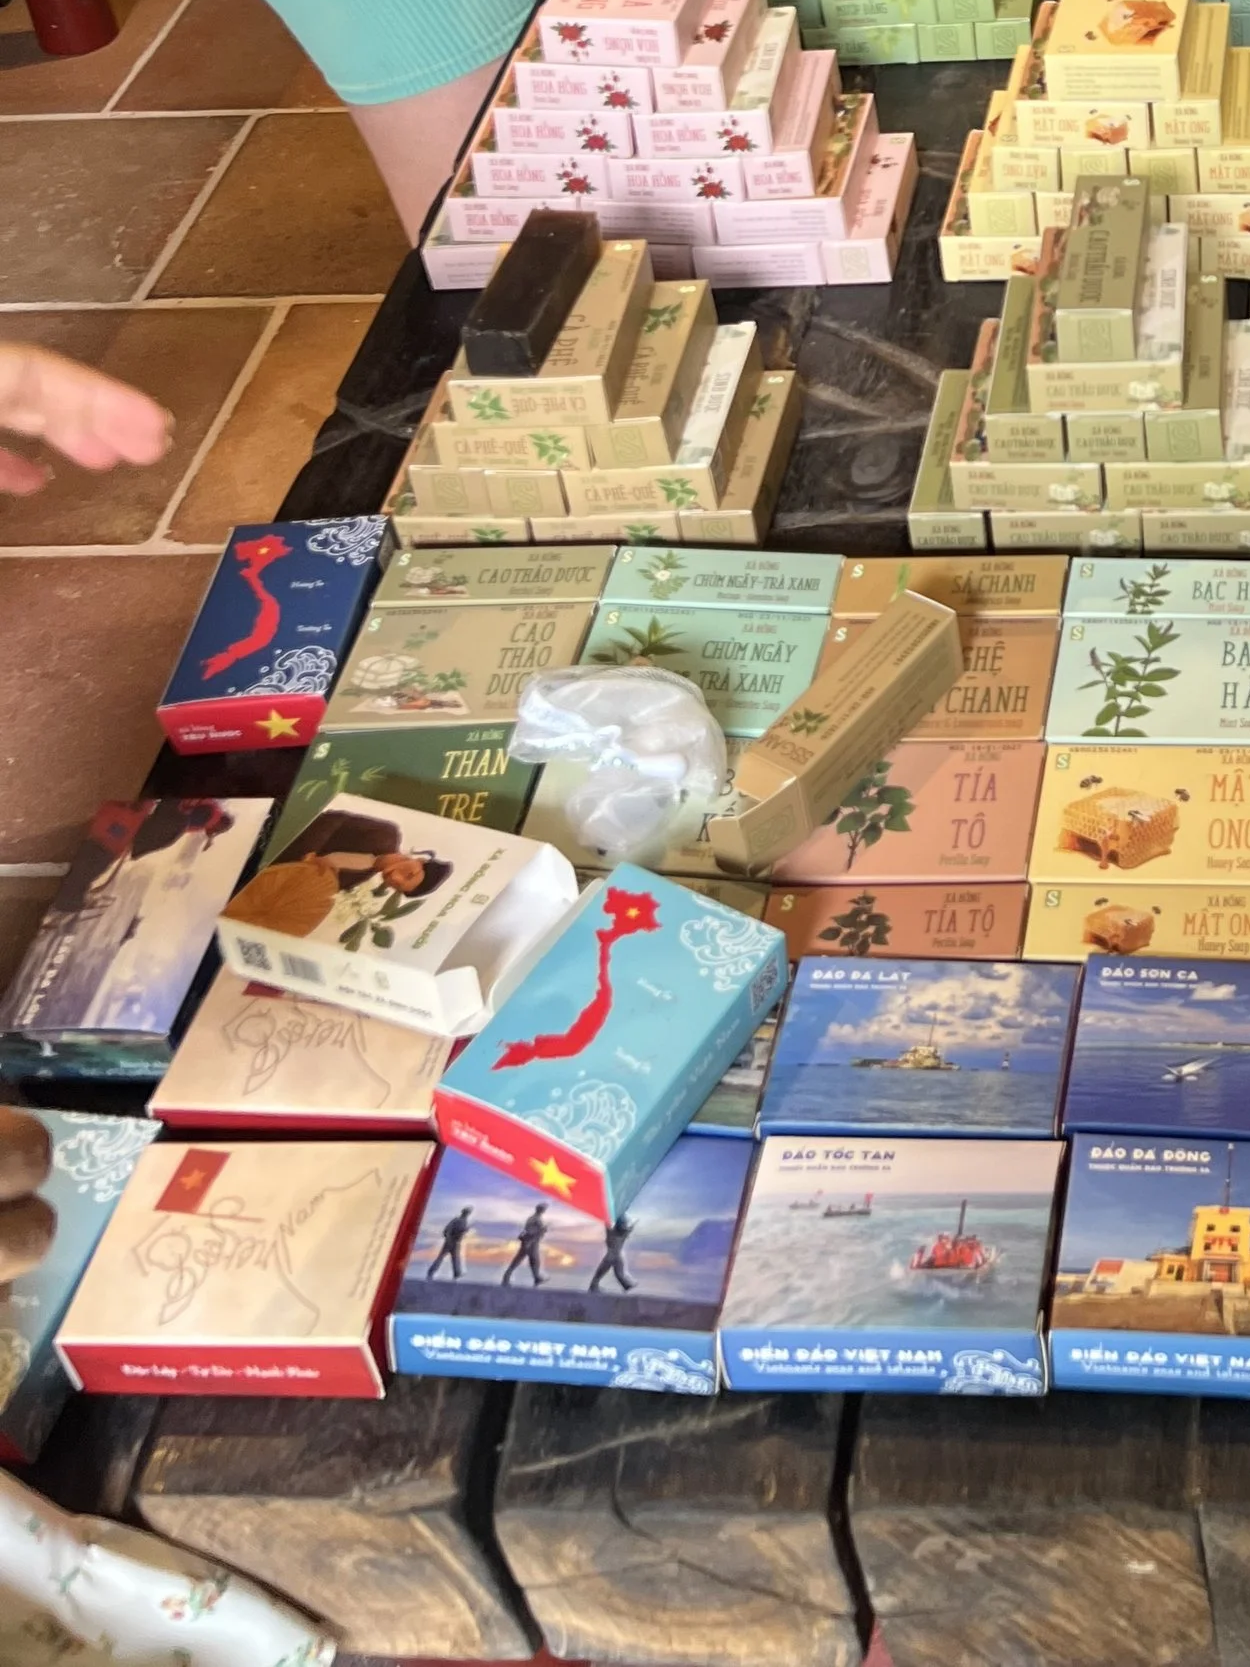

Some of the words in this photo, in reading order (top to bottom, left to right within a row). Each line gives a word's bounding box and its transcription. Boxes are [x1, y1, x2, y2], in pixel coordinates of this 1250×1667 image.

[976, 574, 1036, 594] CHANH
[1192, 581, 1227, 603] BẠC
[510, 621, 556, 643] CAO
[498, 640, 552, 669] THẢO
[702, 636, 747, 661] CHÙM
[733, 674, 785, 694] XANH
[946, 686, 1030, 713] CHANH
[1219, 718, 1237, 729] Mint
[441, 748, 509, 779] THAN
[953, 766, 997, 802] TÍA
[438, 790, 489, 822] TRE
[951, 812, 986, 849] TÔ
[1206, 856, 1233, 870] Honey
[924, 904, 958, 934] TÍA
[1228, 939, 1250, 954] Soap
[1177, 967, 1199, 981] CA
[860, 1149, 897, 1162] TAN
